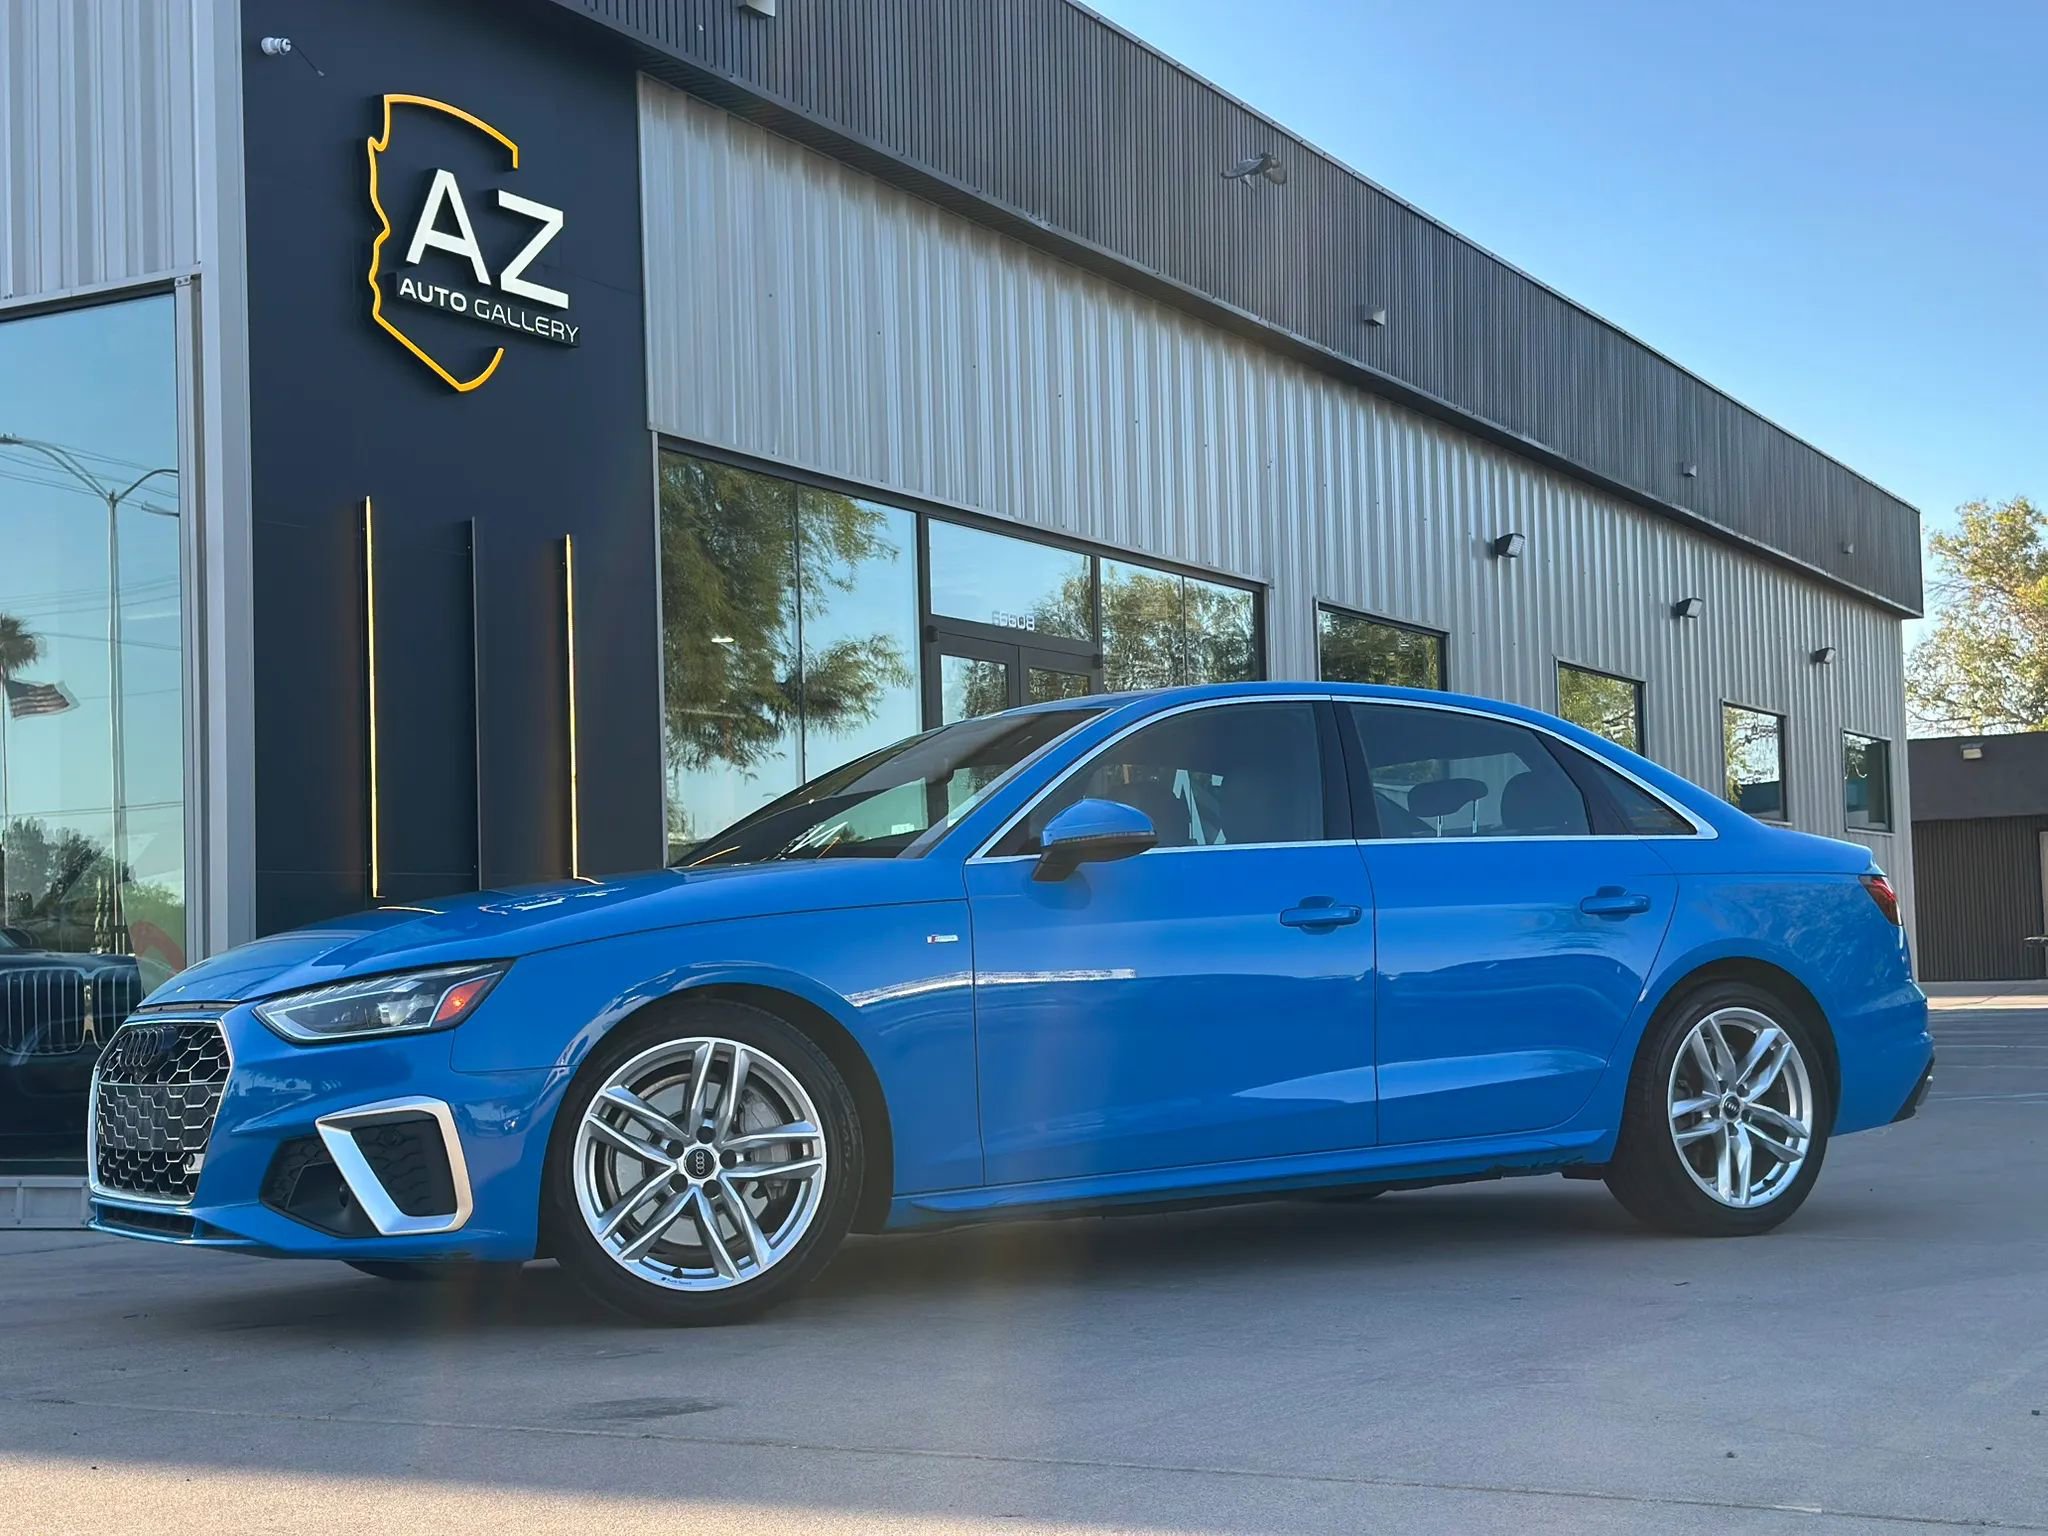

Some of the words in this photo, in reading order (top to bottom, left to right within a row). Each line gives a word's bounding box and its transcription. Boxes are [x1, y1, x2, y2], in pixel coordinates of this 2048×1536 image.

[406, 168, 569, 310] AZ
[400, 278, 467, 312] AUTO
[474, 299, 580, 343] GALLERY
